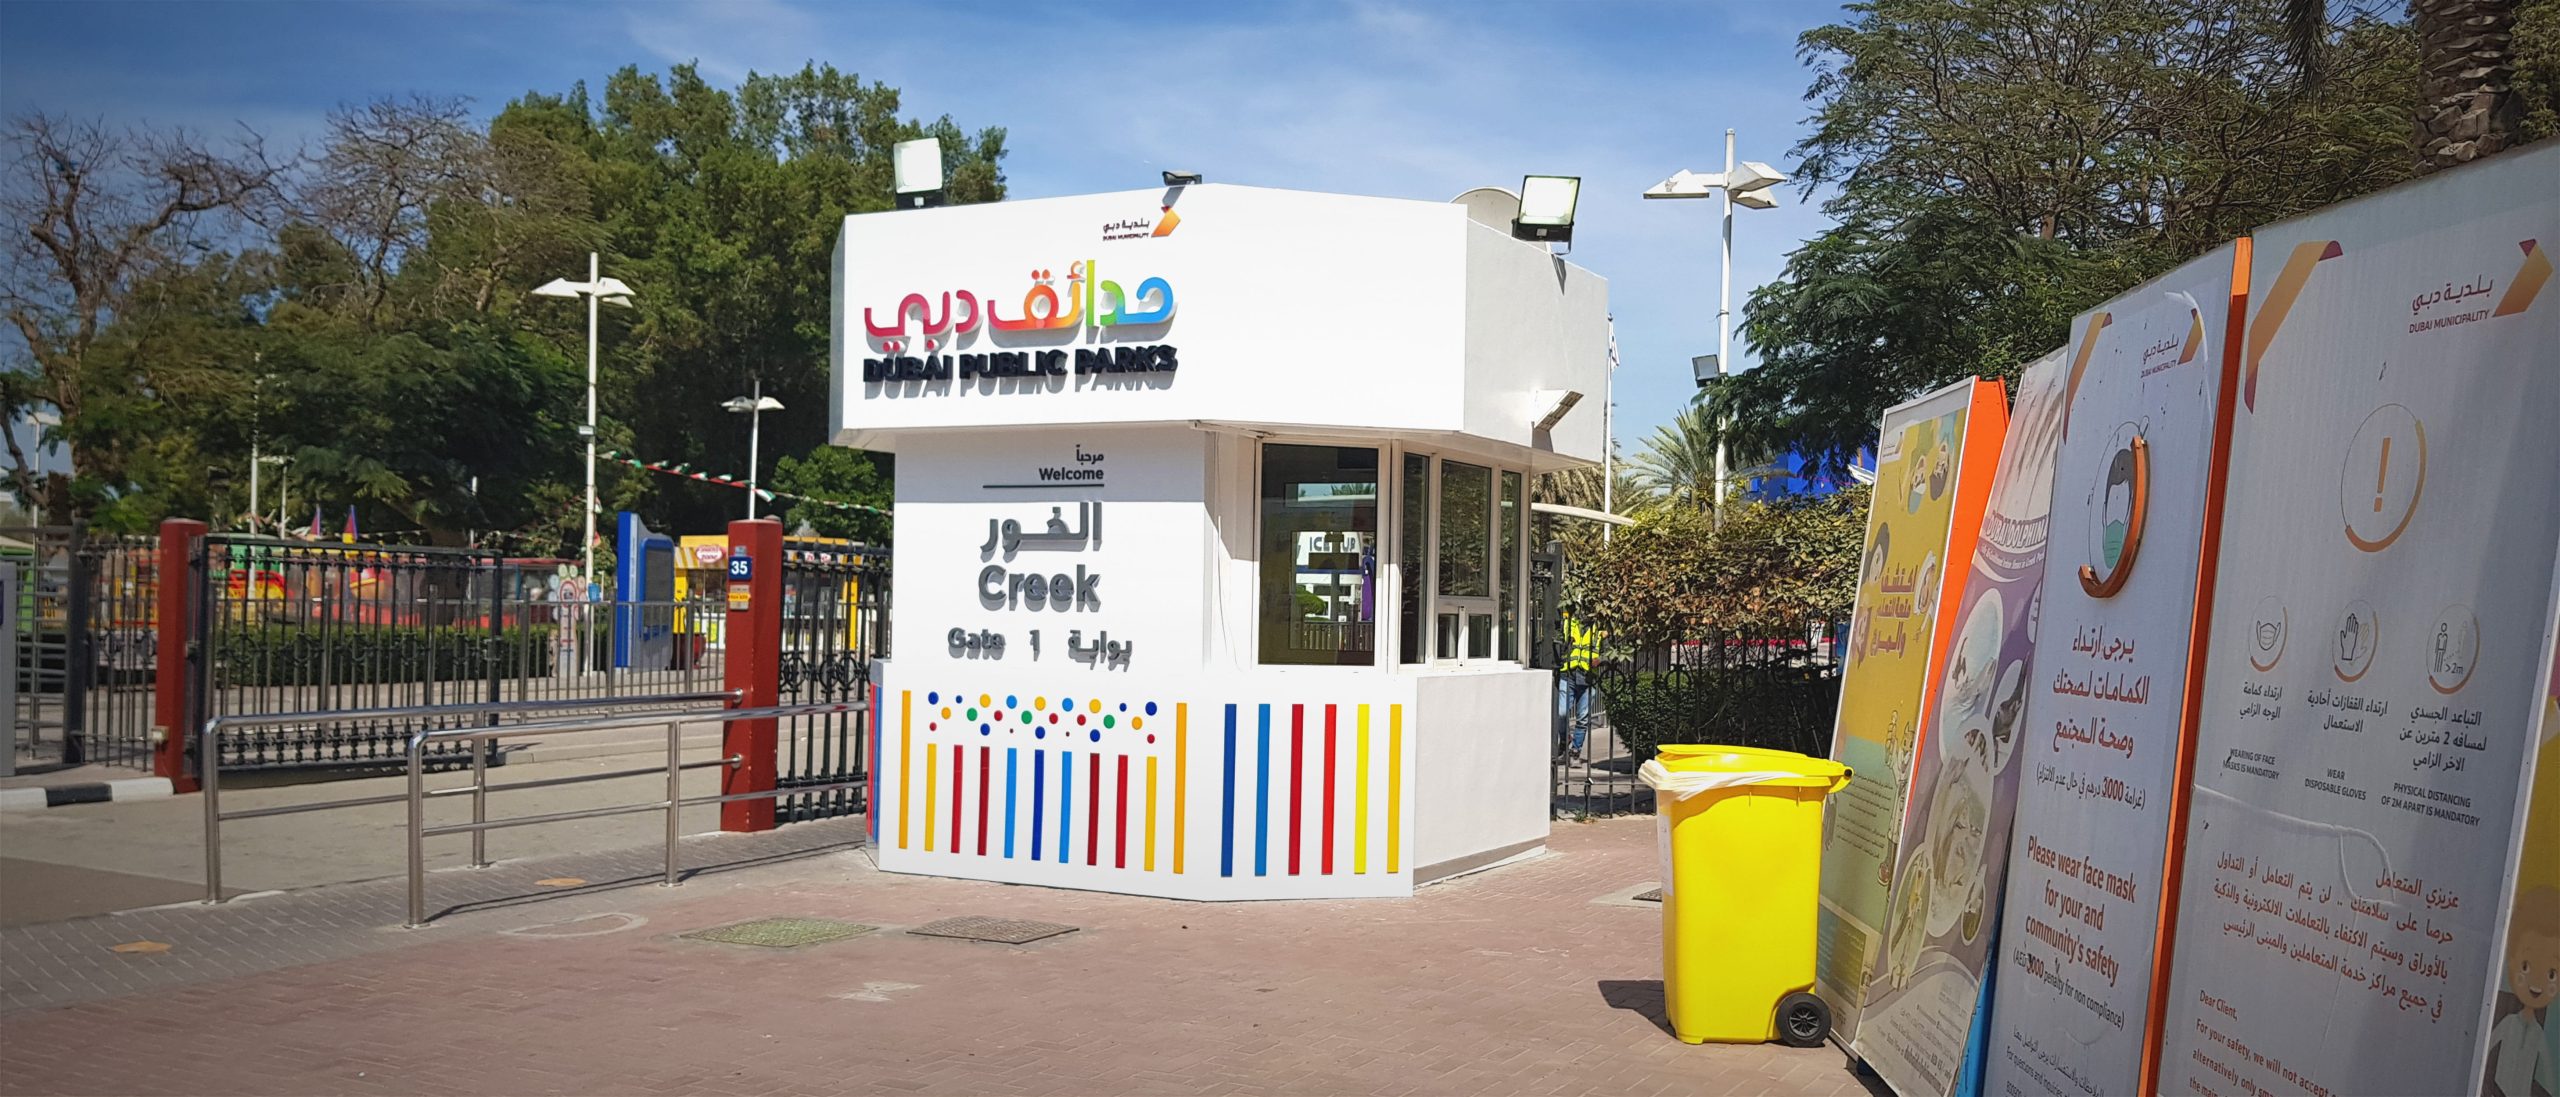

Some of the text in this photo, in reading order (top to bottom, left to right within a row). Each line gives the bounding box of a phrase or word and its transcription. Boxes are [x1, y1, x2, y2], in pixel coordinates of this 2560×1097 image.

[864, 260, 1175, 353] حدائق دبي
[2412, 274, 2494, 316] بلدية دبي
[2409, 309, 2490, 334] DUBAI MUNICIPALITY
[863, 344, 1179, 383] DUBAI PUBLIC PARKS
[1039, 467, 1104, 481] Welcome
[980, 502, 1102, 554] الخور
[731, 560, 748, 575] 35
[978, 564, 1101, 604] Creek
[948, 627, 1006, 652] Gate
[1068, 630, 1132, 663] بوابة
[2072, 624, 2102, 659] ارتداء
[2053, 667, 2150, 705] الكمامات لصحتك
[2243, 680, 2283, 701] ارتداء كمامة
[2262, 706, 2281, 721] الوجه
[2308, 688, 2388, 717] ارتداء القفازات أحادية
[2324, 714, 2364, 733] الاستعمال
[2410, 706, 2482, 729] التباعد الجسدي
[2053, 716, 2134, 760] وصحة المجتمع
[2400, 728, 2412, 741] عن
[2416, 730, 2440, 745] مترين
[2443, 731, 2450, 745] 2
[2230, 748, 2276, 766] WEARING OF FACE
[2066, 771, 2078, 791] حال
[2240, 764, 2246, 774] IS
[2246, 765, 2280, 780] MANDATORY
[2327, 768, 2346, 780] WEAR
[2085, 782, 2101, 800] درهم
[2102, 776, 2124, 802] 3000
[2304, 778, 2367, 801] DISPOSABLE GLOVES
[2393, 782, 2471, 808] PHYSICAL DISTANCING
[2381, 795, 2480, 827] OF 2M APART IS MANDATORY
[2027, 835, 2136, 904] Please wear face mask
[2217, 851, 2245, 872] التداول
[2248, 855, 2259, 879] أو
[2262, 865, 2294, 890] التعامل
[2375, 868, 2459, 910] عزيزي المتعامل
[2298, 881, 2313, 901] يتم
[2319, 885, 2332, 904] لن
[2044, 879, 2105, 932] for your and
[2350, 895, 2390, 921] سلامتك
[2214, 878, 2448, 986] بالأوراق وسيتم الاكتفاء بالتعاملات الالكترونية والذكية
[2396, 911, 2418, 932] على
[2426, 918, 2453, 945] حرصا
[2026, 915, 2120, 988] community's safety
[2223, 918, 2443, 1024] في جميع مراكز خدمة المتعاملين والمبنى الرئيسي
[2044, 970, 2065, 996] penalty
[2065, 978, 2074, 998] for
[2074, 989, 2086, 1006] non
[2200, 989, 2238, 1022] Dear Client,
[2196, 1018, 2329, 1097] For your safety, we will not accept
[2190, 1076, 2200, 1092] the
[2192, 1048, 2258, 1096] alternatively only
